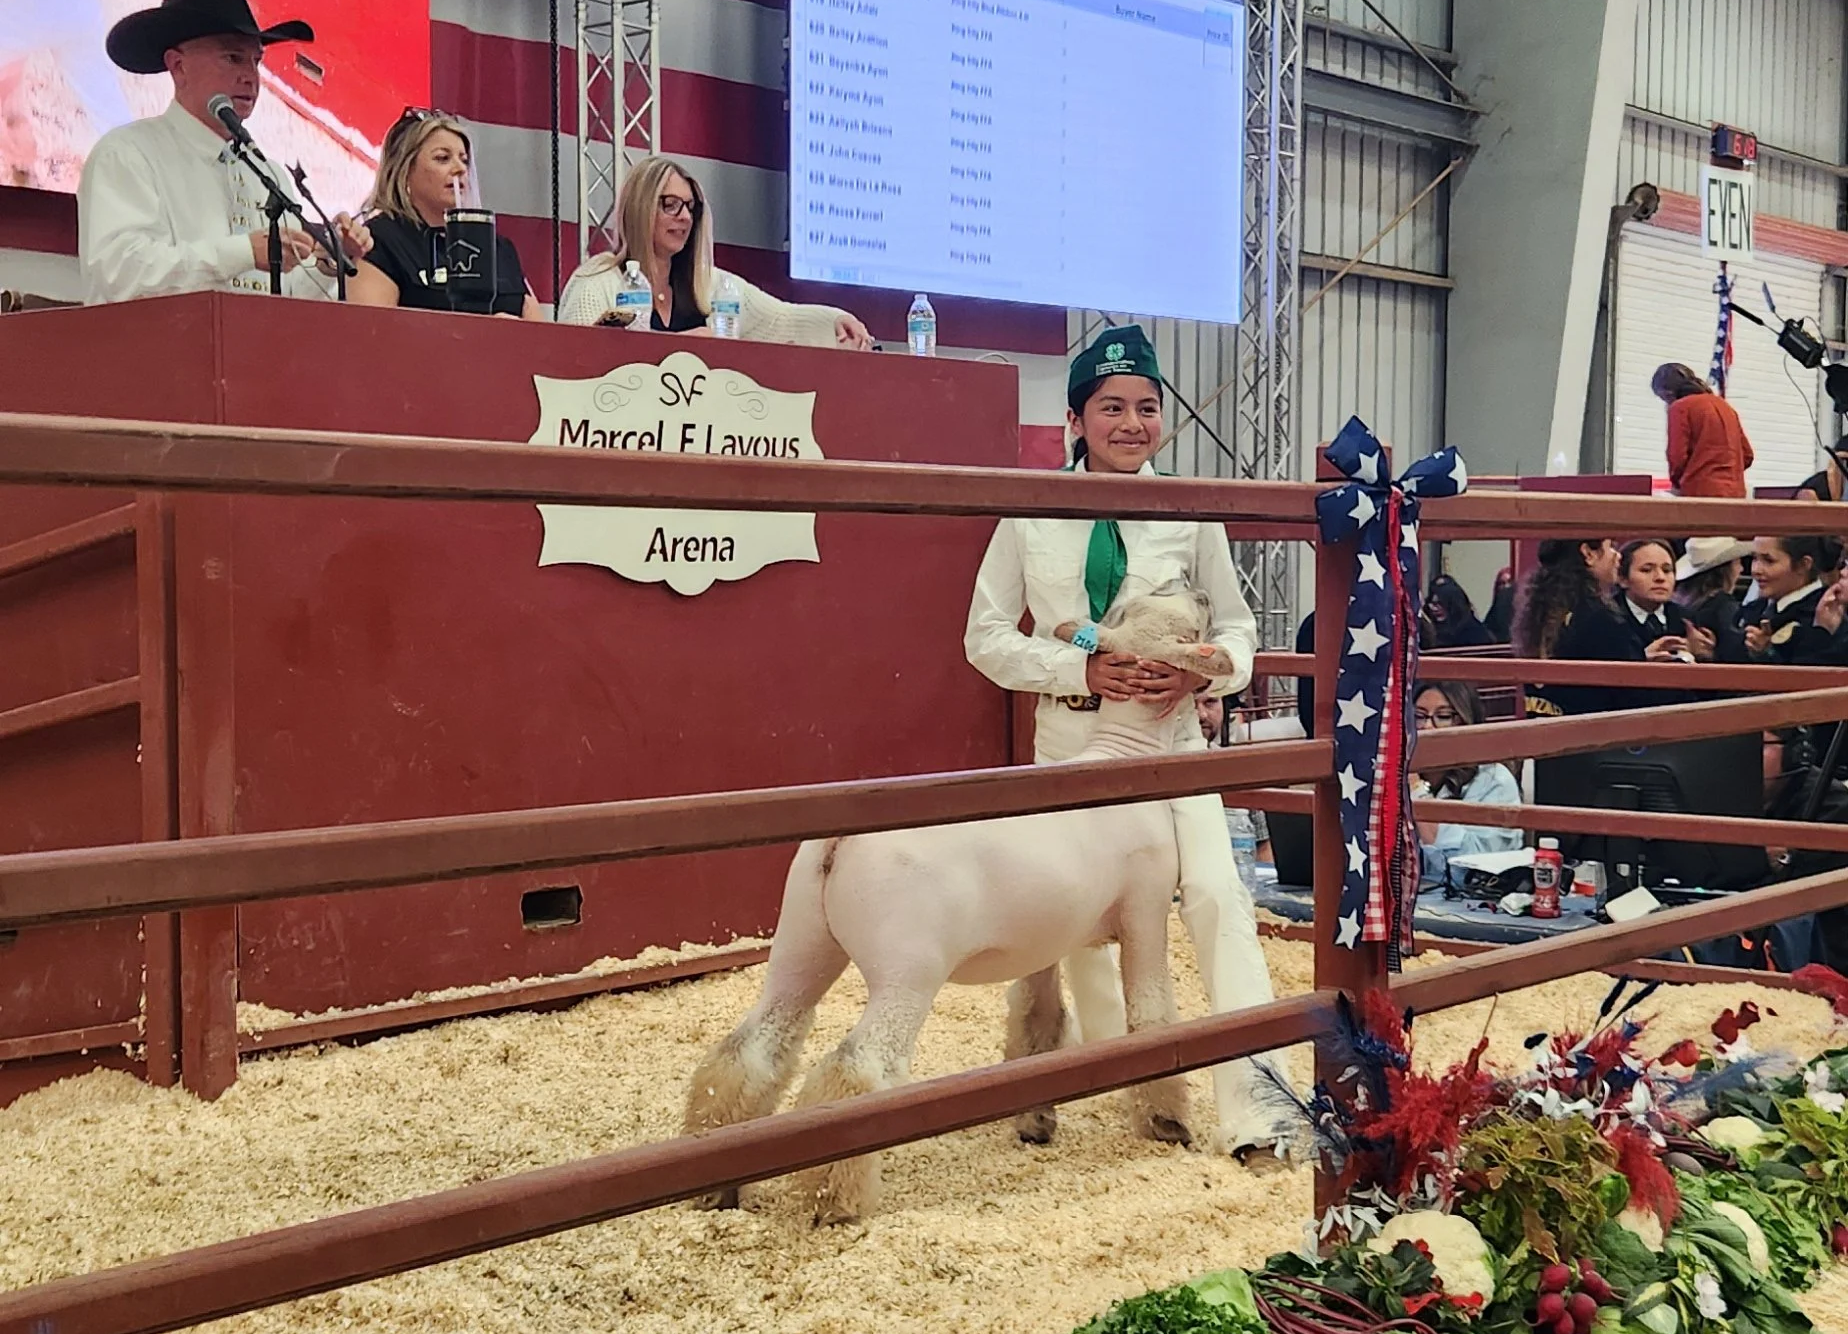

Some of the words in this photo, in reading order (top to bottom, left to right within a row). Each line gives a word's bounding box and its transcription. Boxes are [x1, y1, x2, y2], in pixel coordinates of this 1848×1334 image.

[1707, 177, 1751, 252] EVEN
[659, 372, 706, 407] SVF
[558, 418, 664, 452] Marcel
[645, 527, 735, 563] Arena
